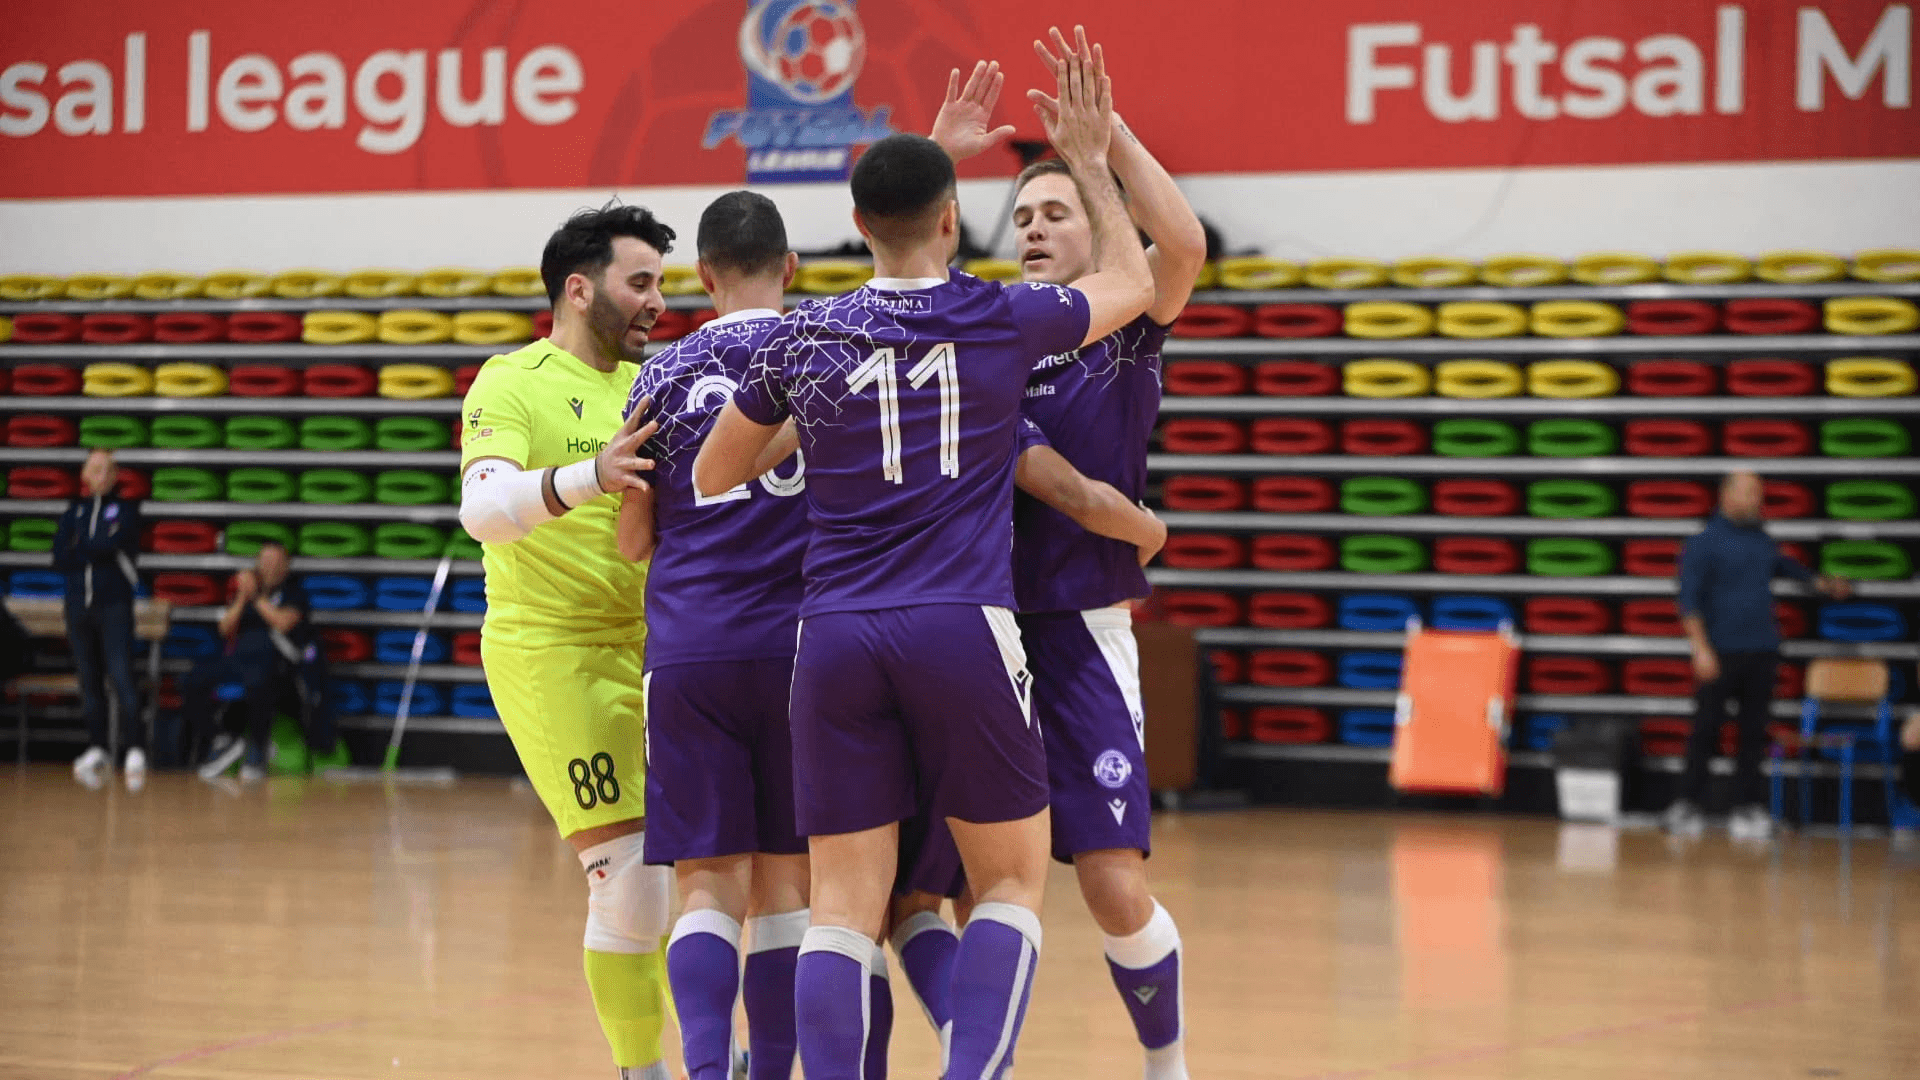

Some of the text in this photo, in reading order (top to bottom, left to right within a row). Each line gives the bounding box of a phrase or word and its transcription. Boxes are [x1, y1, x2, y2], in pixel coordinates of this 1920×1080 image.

[0, 30, 586, 154] sal league
[1345, 2, 1912, 124] Futsal M
[845, 342, 960, 484] 11
[567, 751, 620, 810] 88
